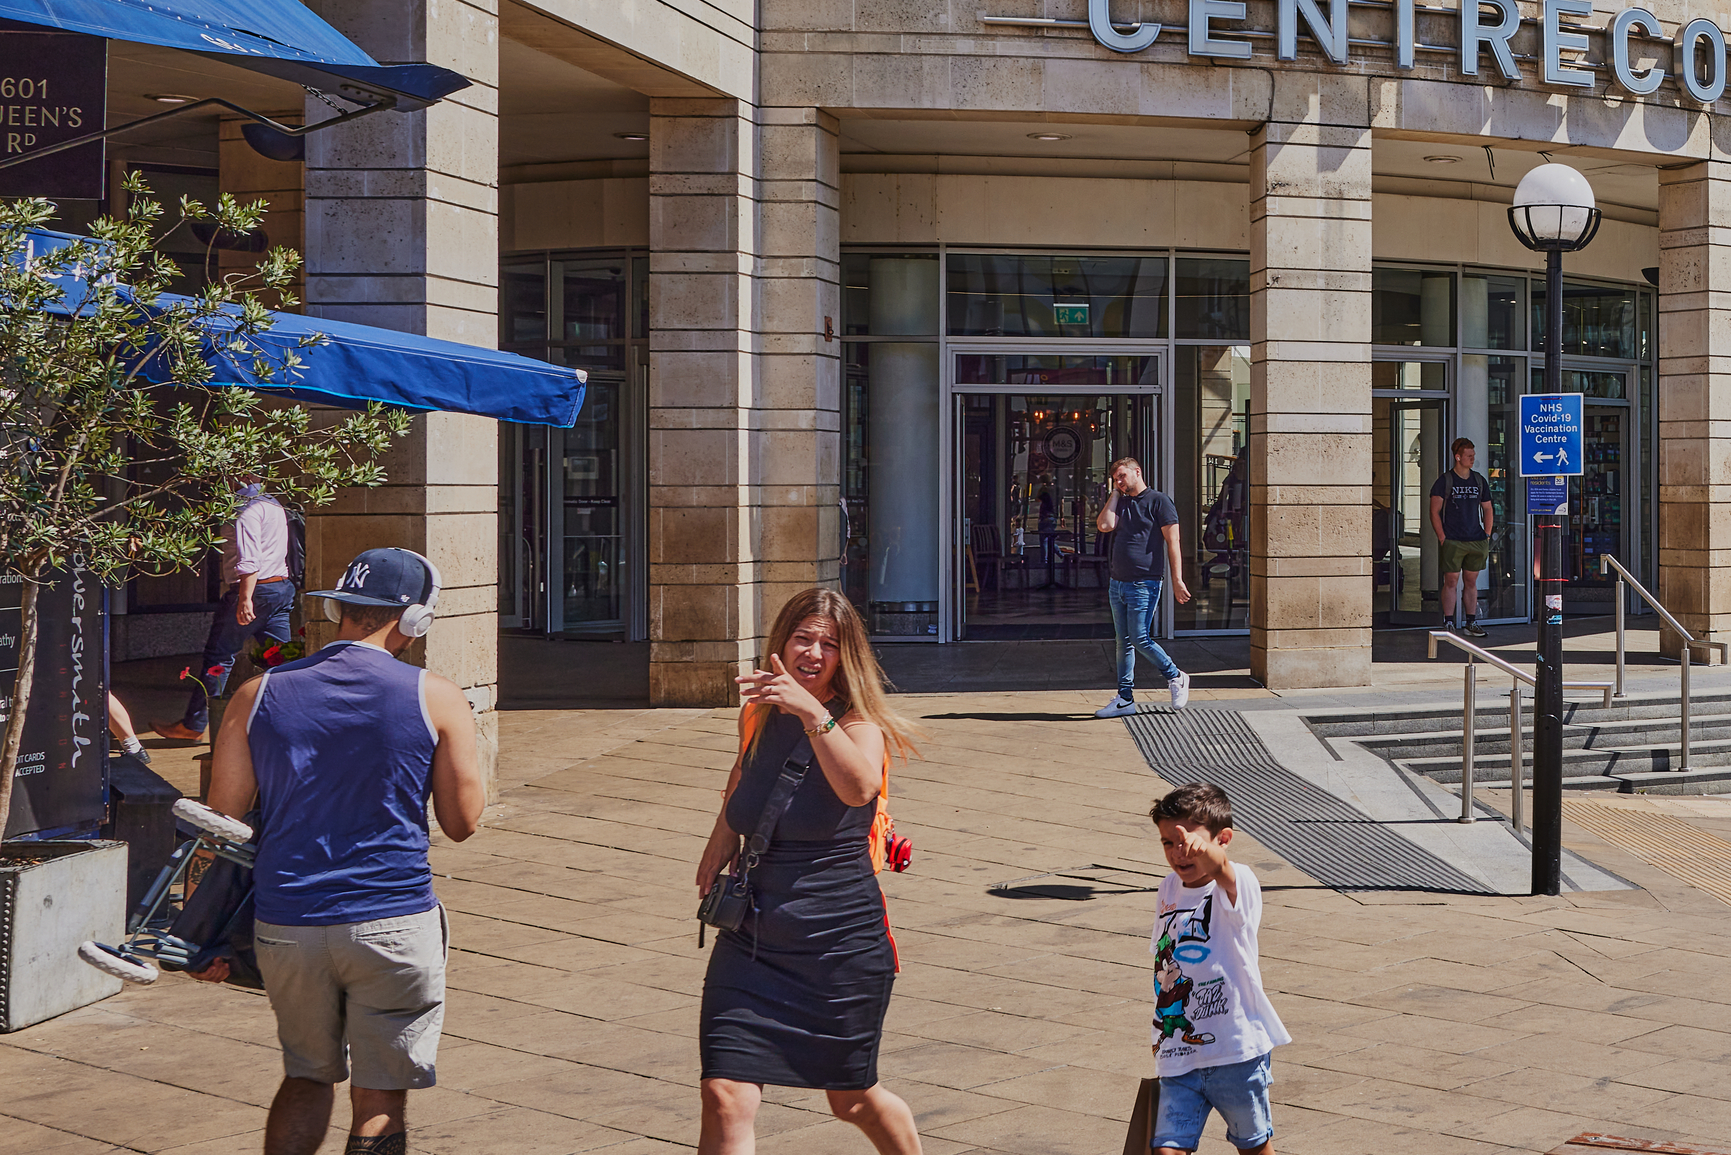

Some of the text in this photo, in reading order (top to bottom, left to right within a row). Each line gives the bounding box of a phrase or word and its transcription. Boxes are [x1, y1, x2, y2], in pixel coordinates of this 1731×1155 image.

[1, 77, 48, 99] 601
[1540, 403, 1563, 413] NHS
[1531, 413, 1572, 423] Covid-19
[1524, 424, 1578, 434] Vaccination
[1052, 439, 1073, 448] M&S
[1535, 434, 1568, 444] Centre
[1451, 486, 1479, 496] NIKE
[24, 751, 46, 763] CARDS
[14, 764, 46, 778] ACCEPTED
